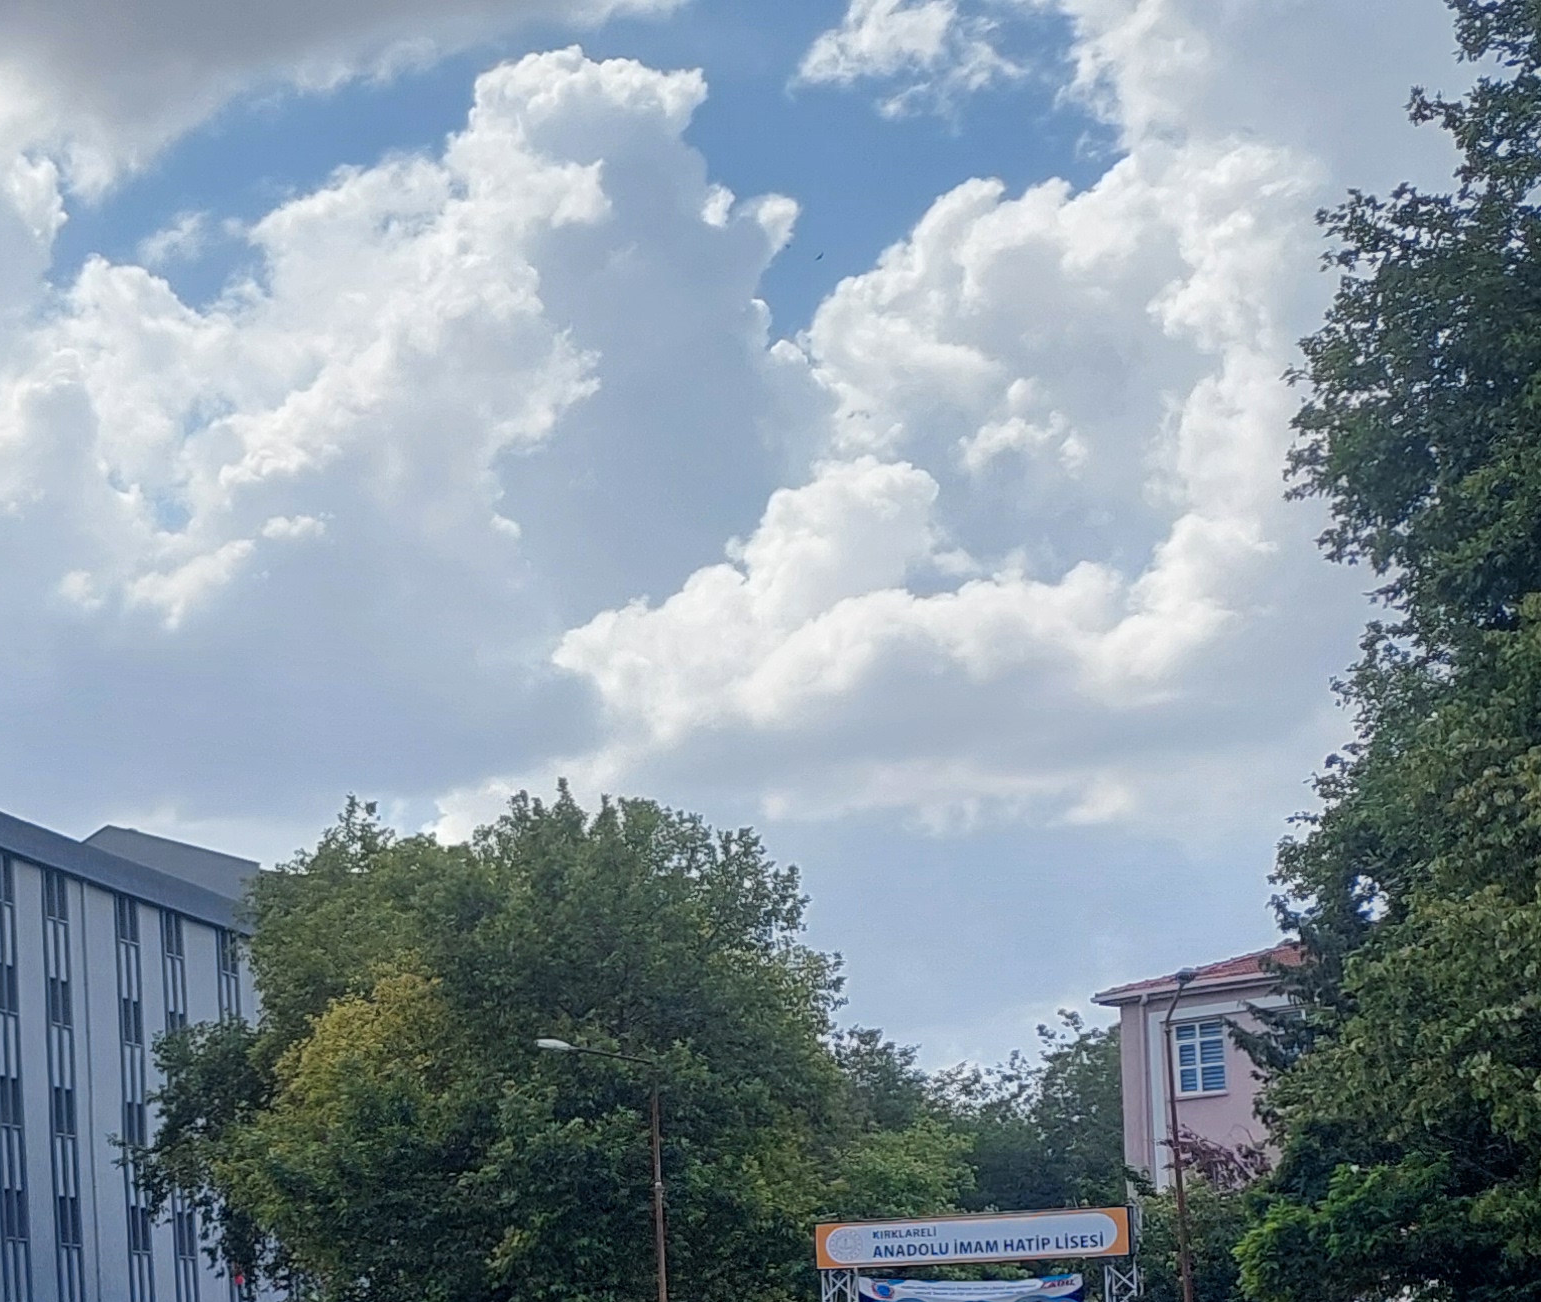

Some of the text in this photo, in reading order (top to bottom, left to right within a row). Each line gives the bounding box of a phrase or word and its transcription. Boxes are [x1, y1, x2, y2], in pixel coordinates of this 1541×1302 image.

[872, 1226, 937, 1239] KIRKLARELİ
[872, 1230, 1104, 1258] ANADOLU İMAM HATİP LİSESİ
